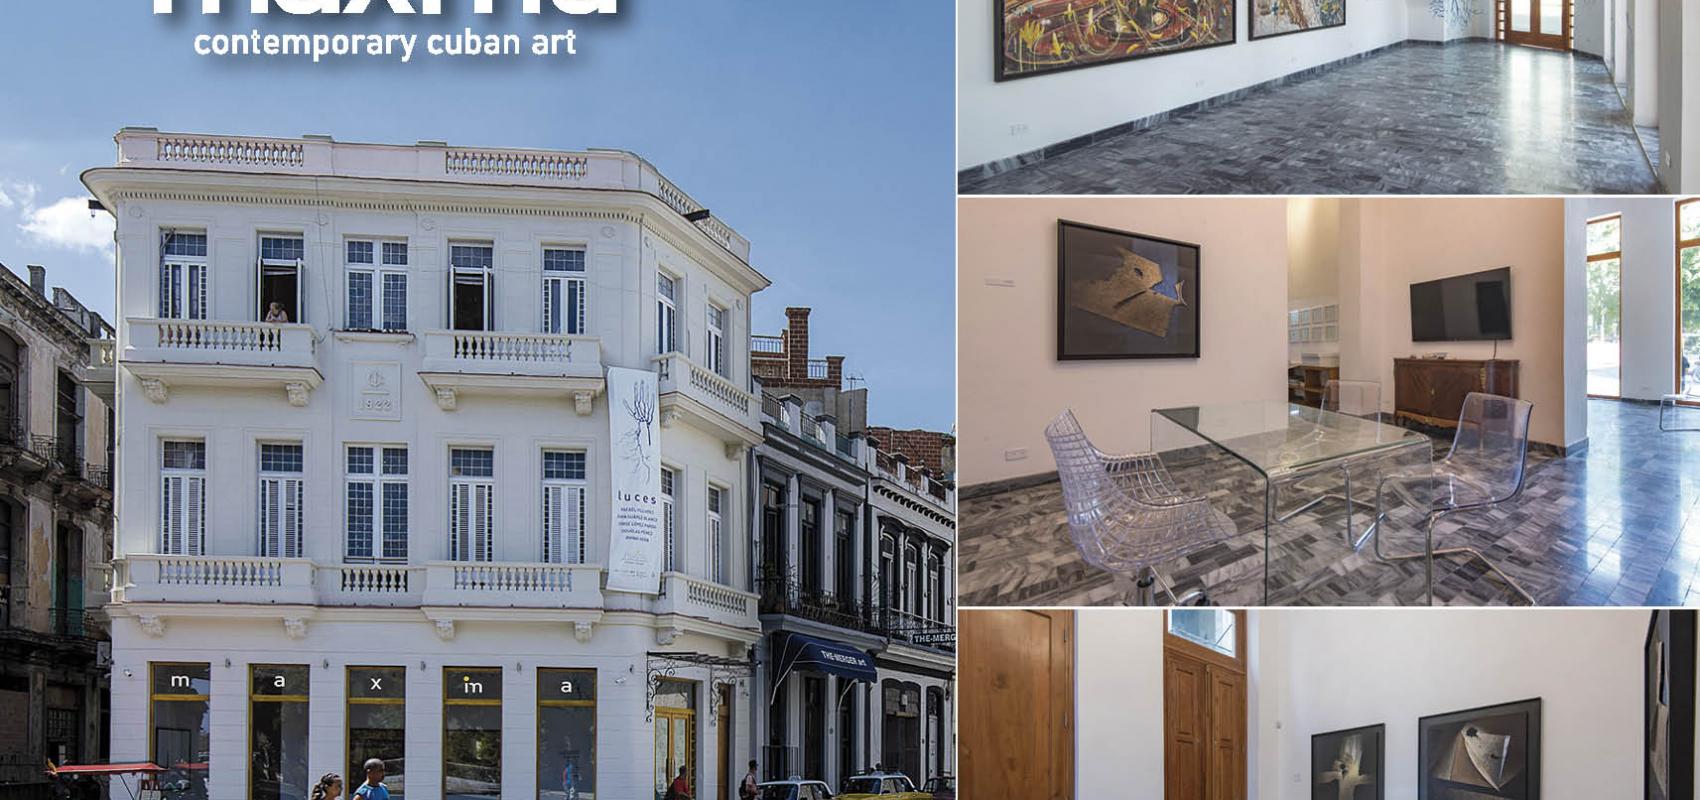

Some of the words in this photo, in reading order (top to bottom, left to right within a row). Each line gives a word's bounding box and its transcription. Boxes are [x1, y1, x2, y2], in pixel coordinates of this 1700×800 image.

[618, 490, 656, 504] luces
[171, 675, 190, 687] m
[274, 675, 285, 687] a
[370, 678, 382, 690] x
[560, 681, 572, 693] a
